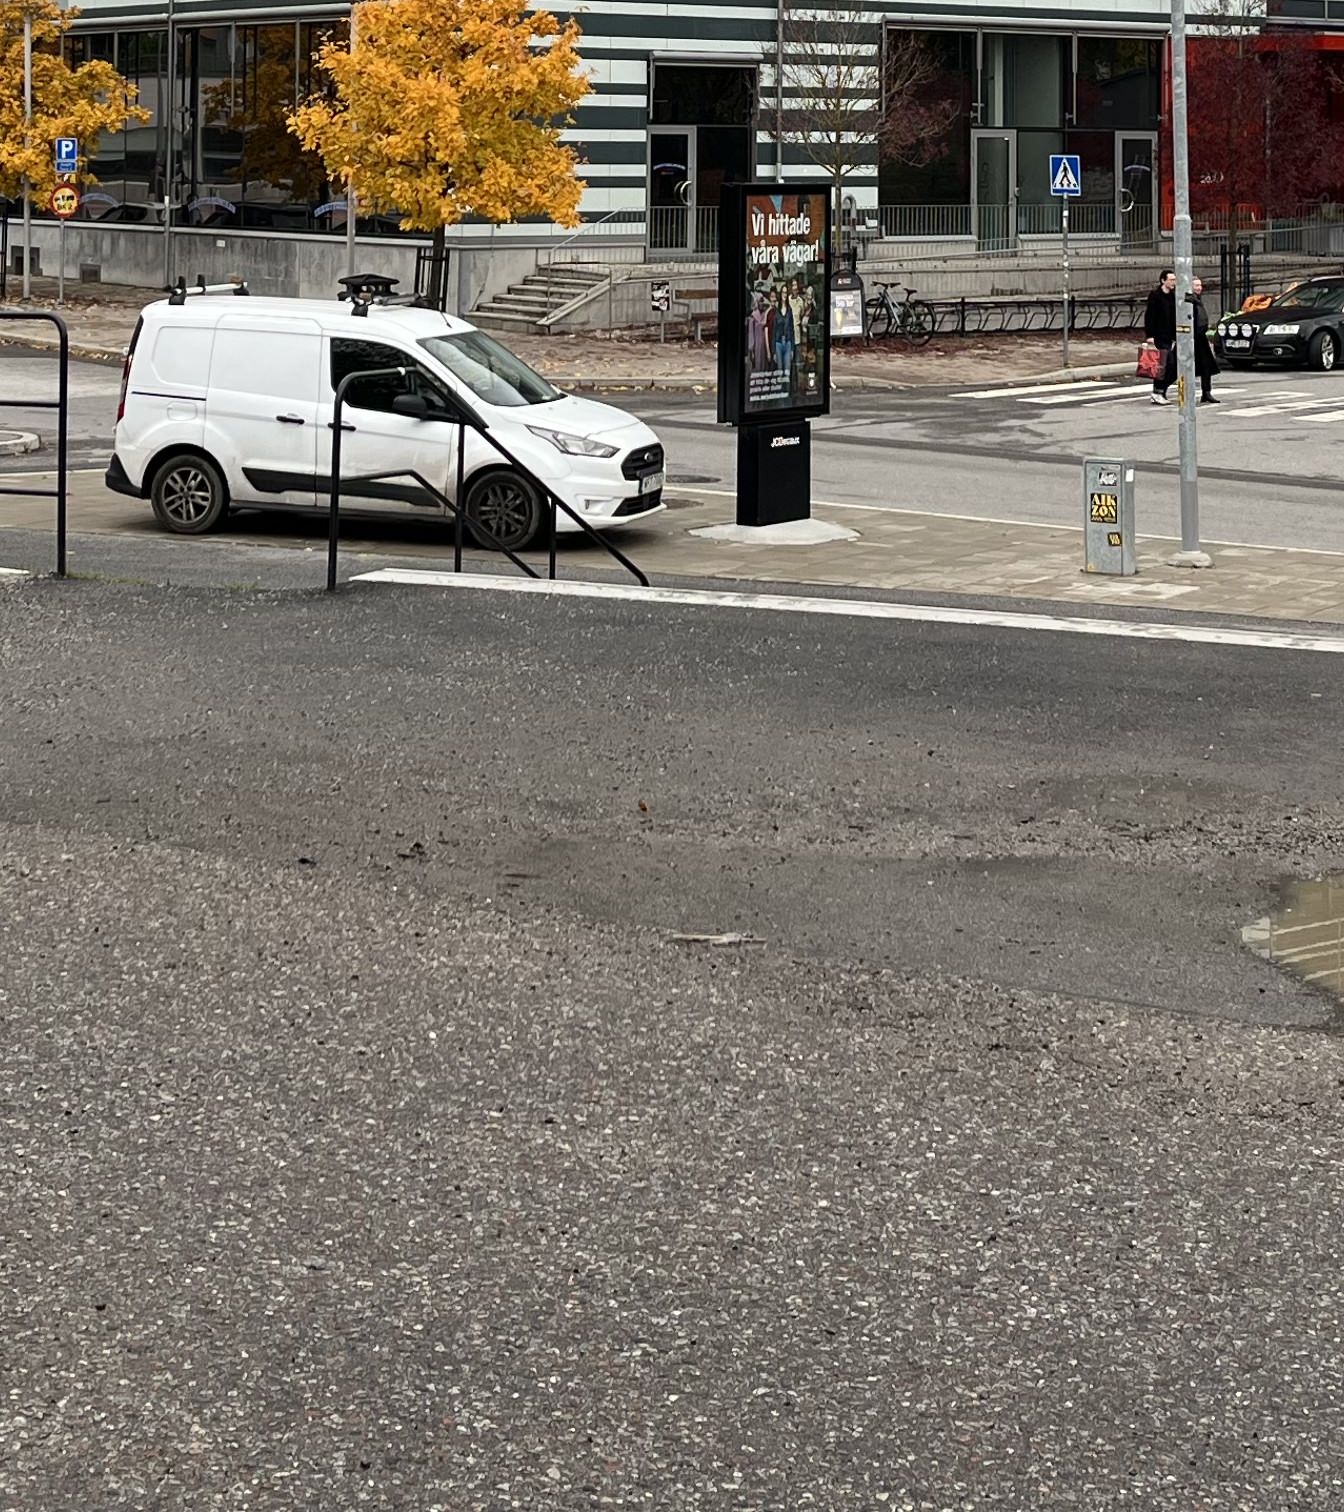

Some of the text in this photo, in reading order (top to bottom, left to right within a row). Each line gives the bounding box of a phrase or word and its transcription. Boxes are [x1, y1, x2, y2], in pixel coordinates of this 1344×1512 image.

[61, 140, 73, 159] P
[751, 212, 811, 236] Vi hittade
[752, 239, 820, 267] våra vägar!
[1091, 493, 1116, 506] AIK
